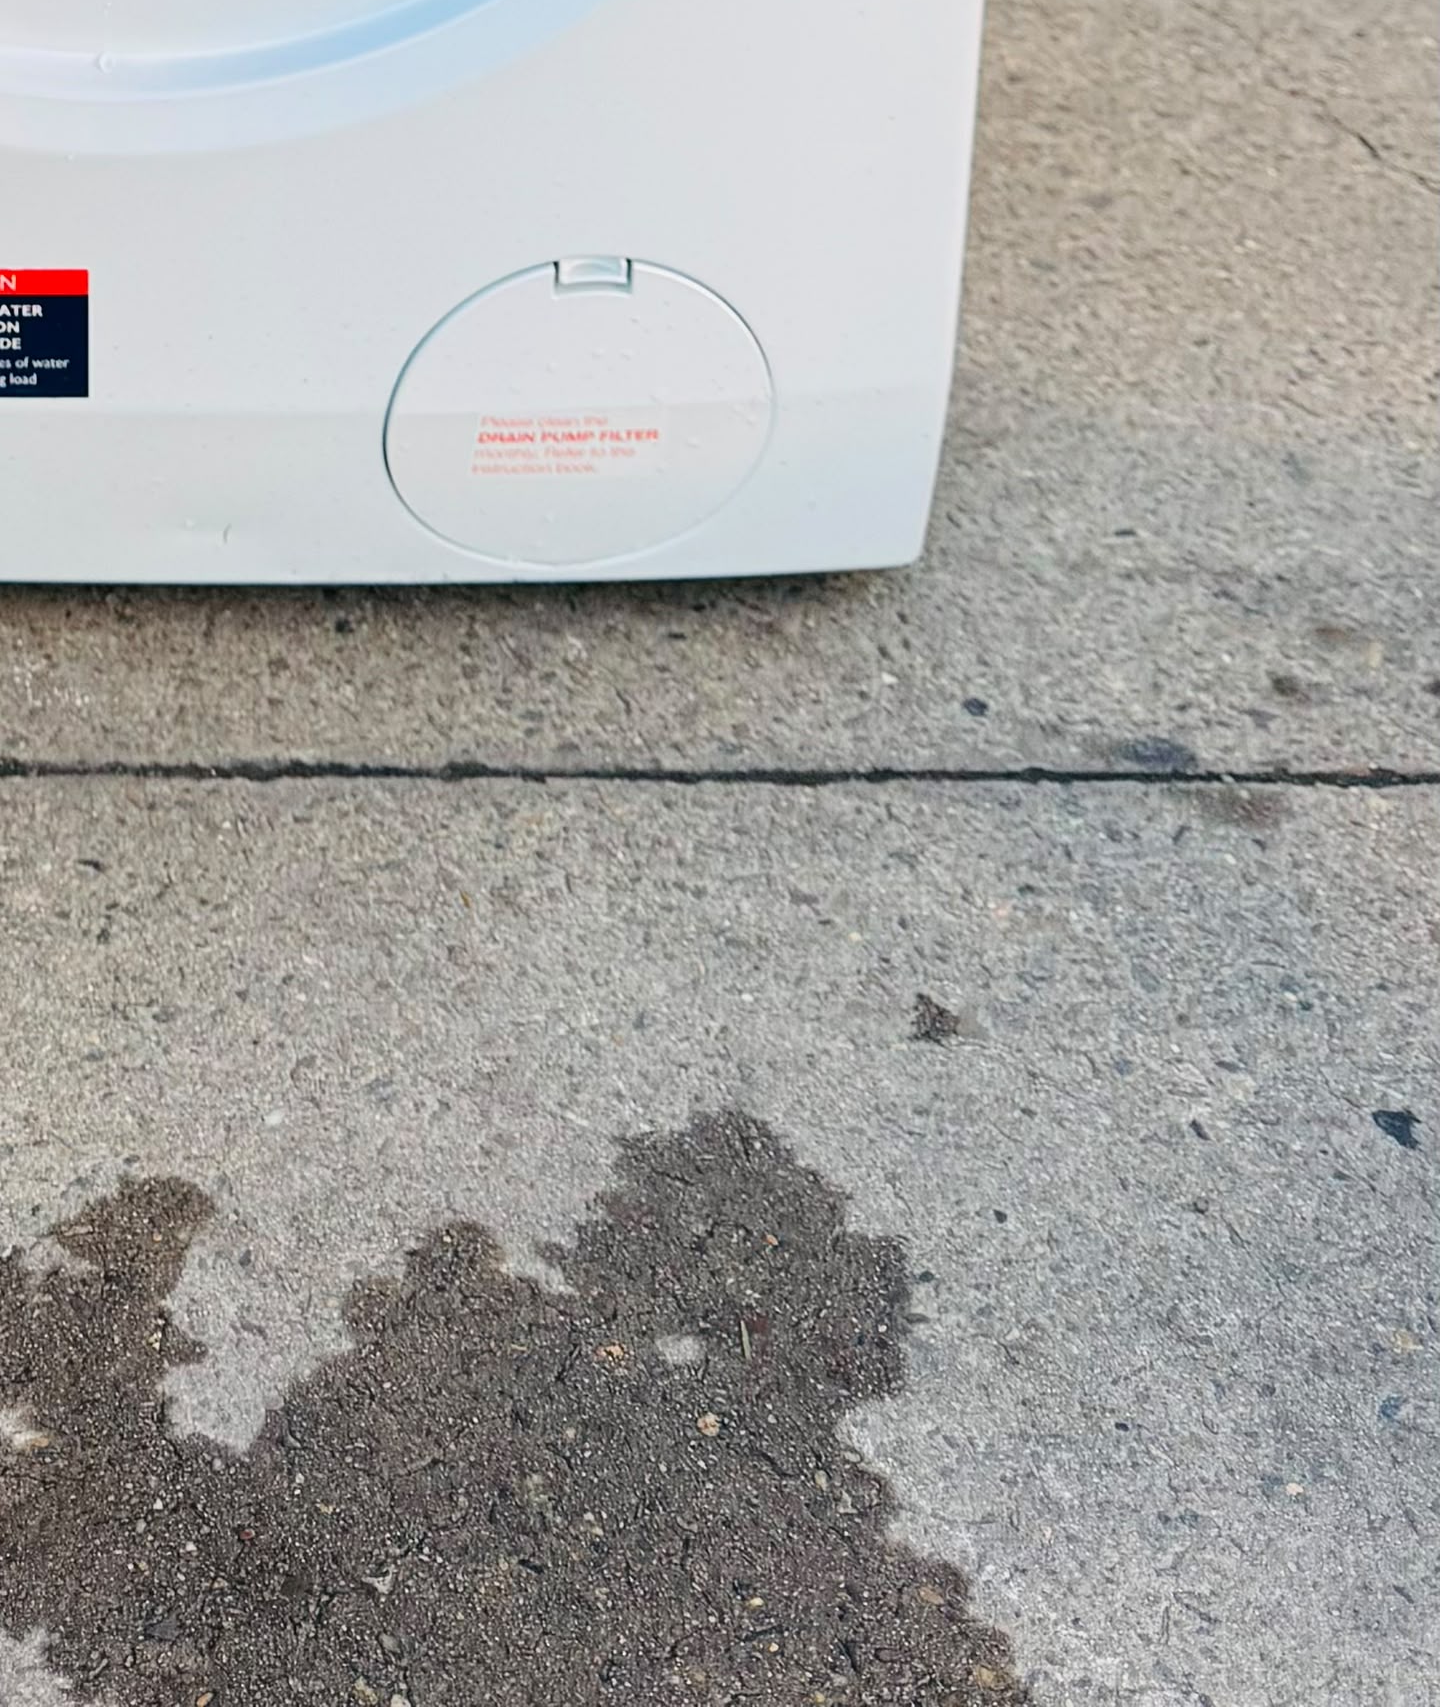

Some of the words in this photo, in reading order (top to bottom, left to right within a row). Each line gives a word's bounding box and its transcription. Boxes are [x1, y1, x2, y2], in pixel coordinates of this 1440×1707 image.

[15, 356, 29, 369] of
[31, 358, 70, 369] water
[10, 373, 38, 386] load
[478, 430, 536, 444] DRAIN
[540, 429, 595, 443] PUMP
[599, 428, 660, 442] FILTER
